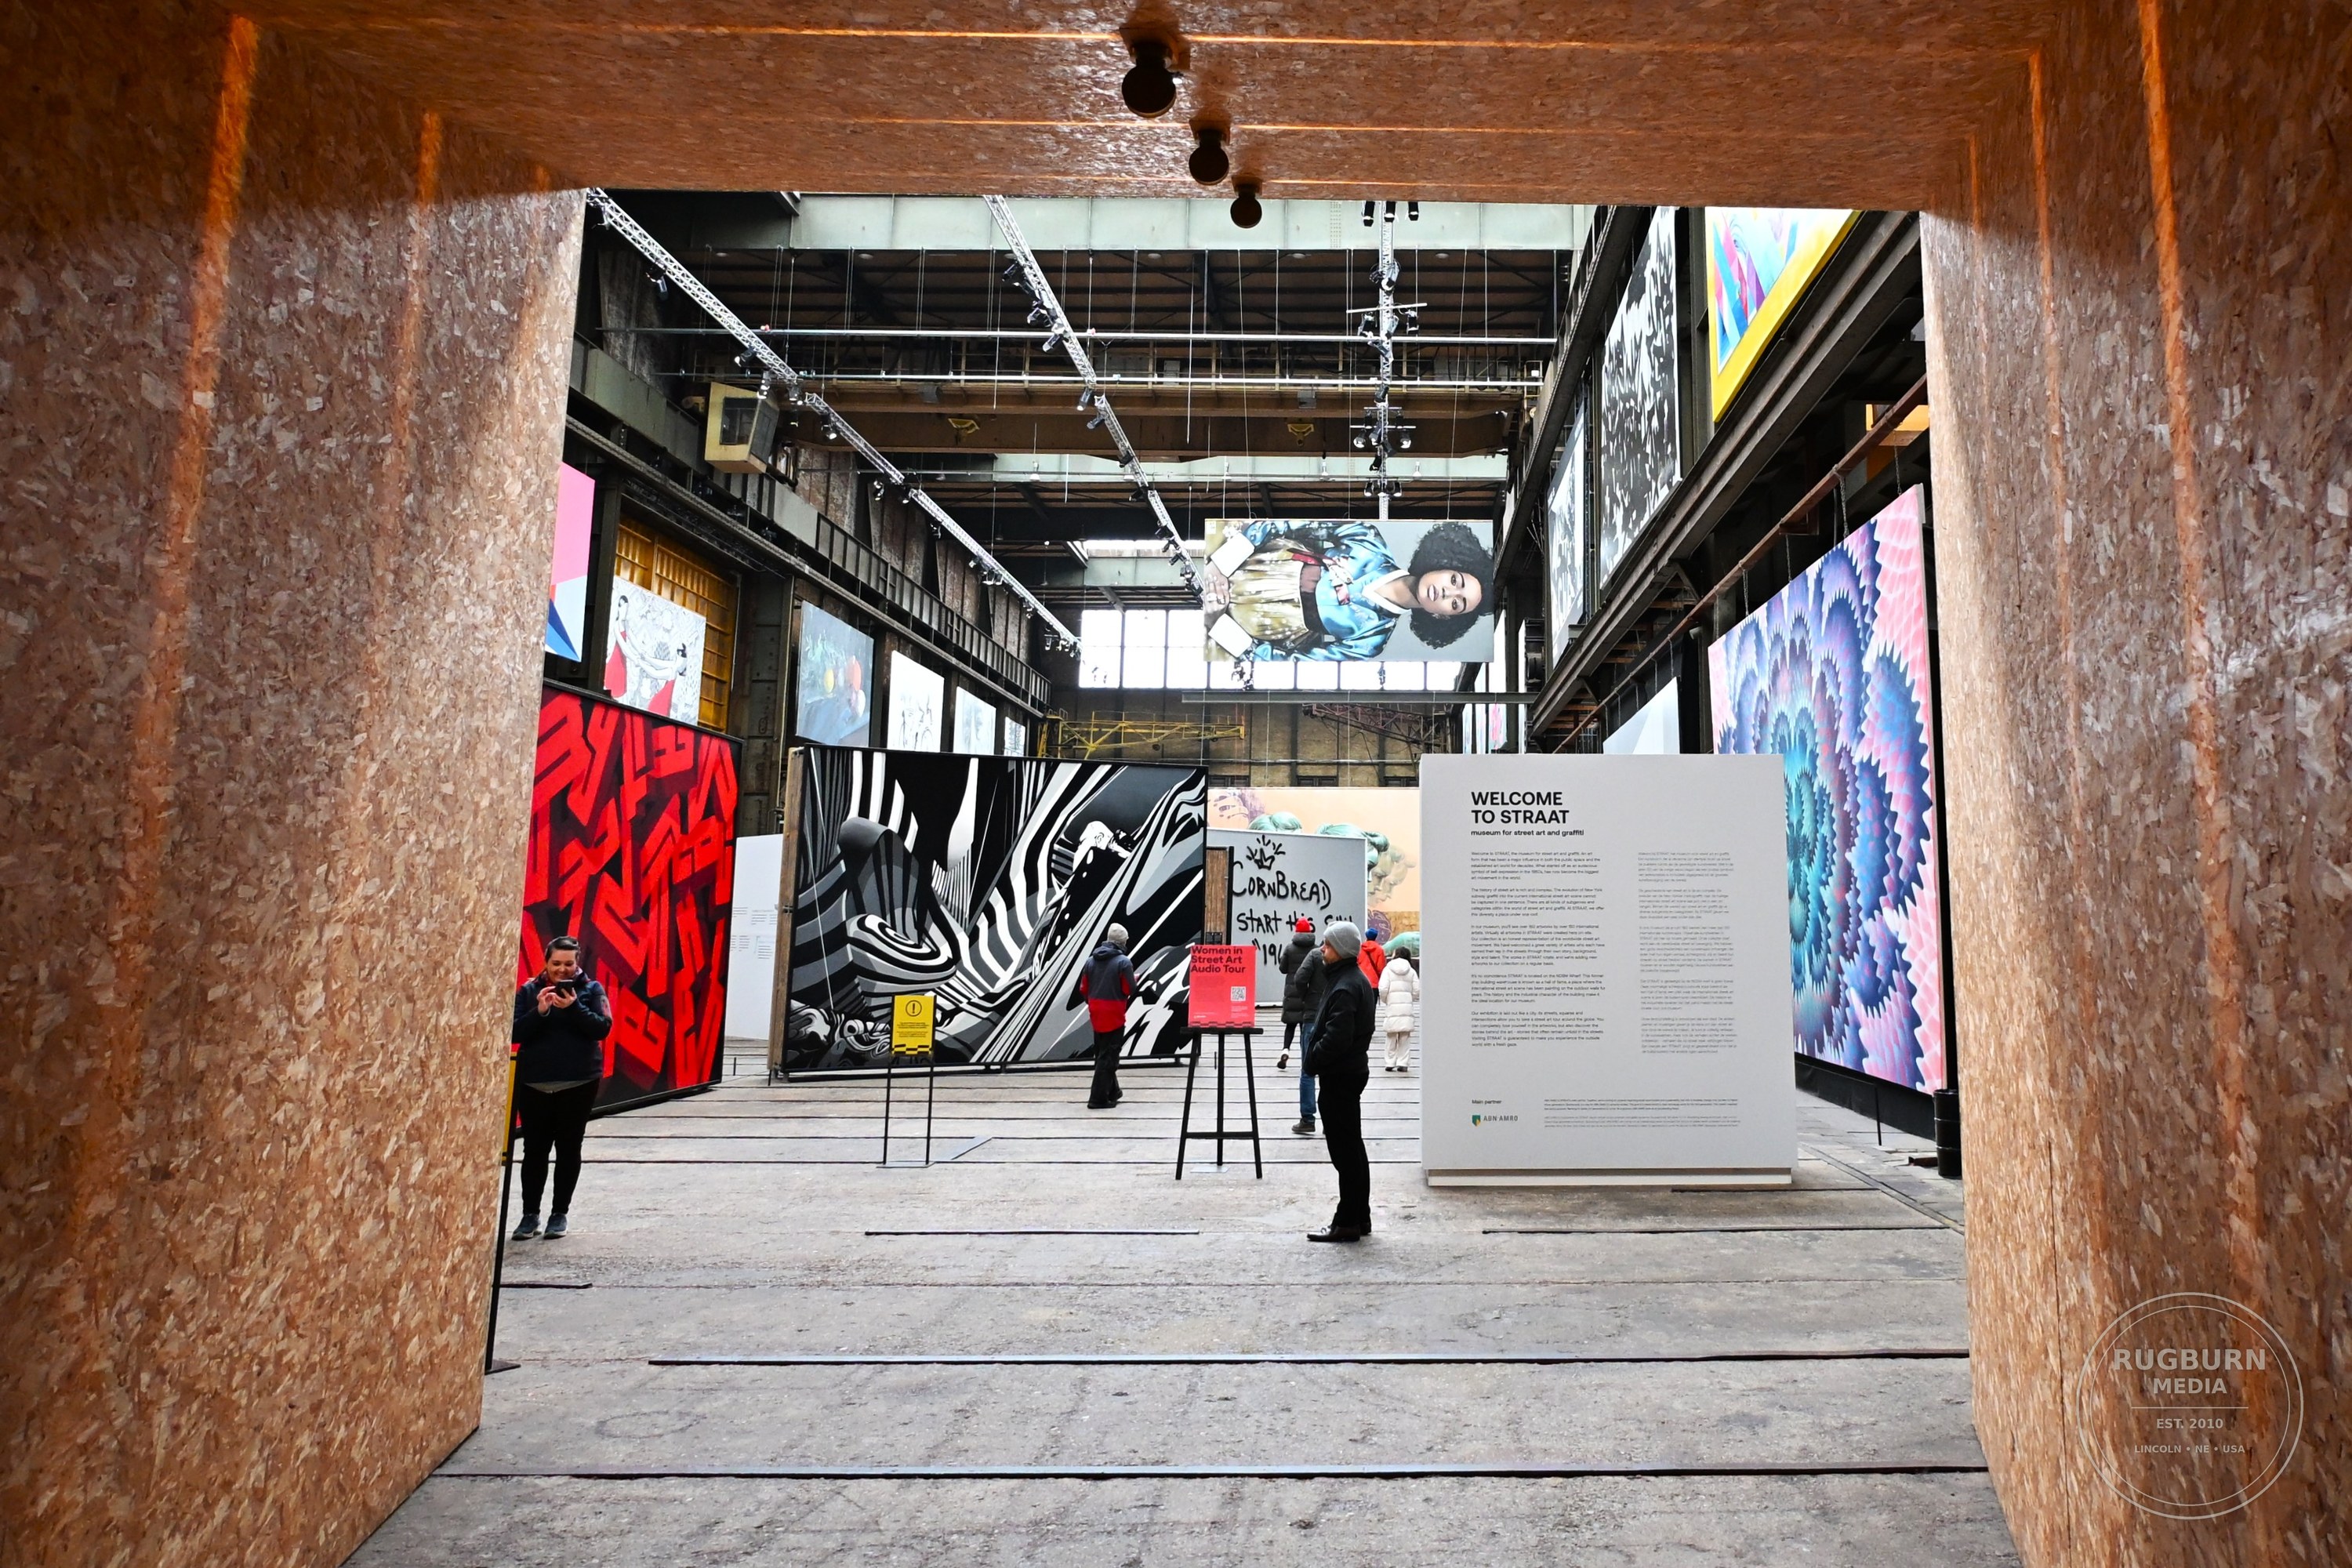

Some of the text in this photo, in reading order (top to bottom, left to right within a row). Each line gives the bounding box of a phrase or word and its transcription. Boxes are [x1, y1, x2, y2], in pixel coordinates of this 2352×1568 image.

[1471, 792, 1563, 805] WELCOME
[1471, 810, 1570, 824] TO STRAAT
[1223, 964, 1246, 973] Tour
